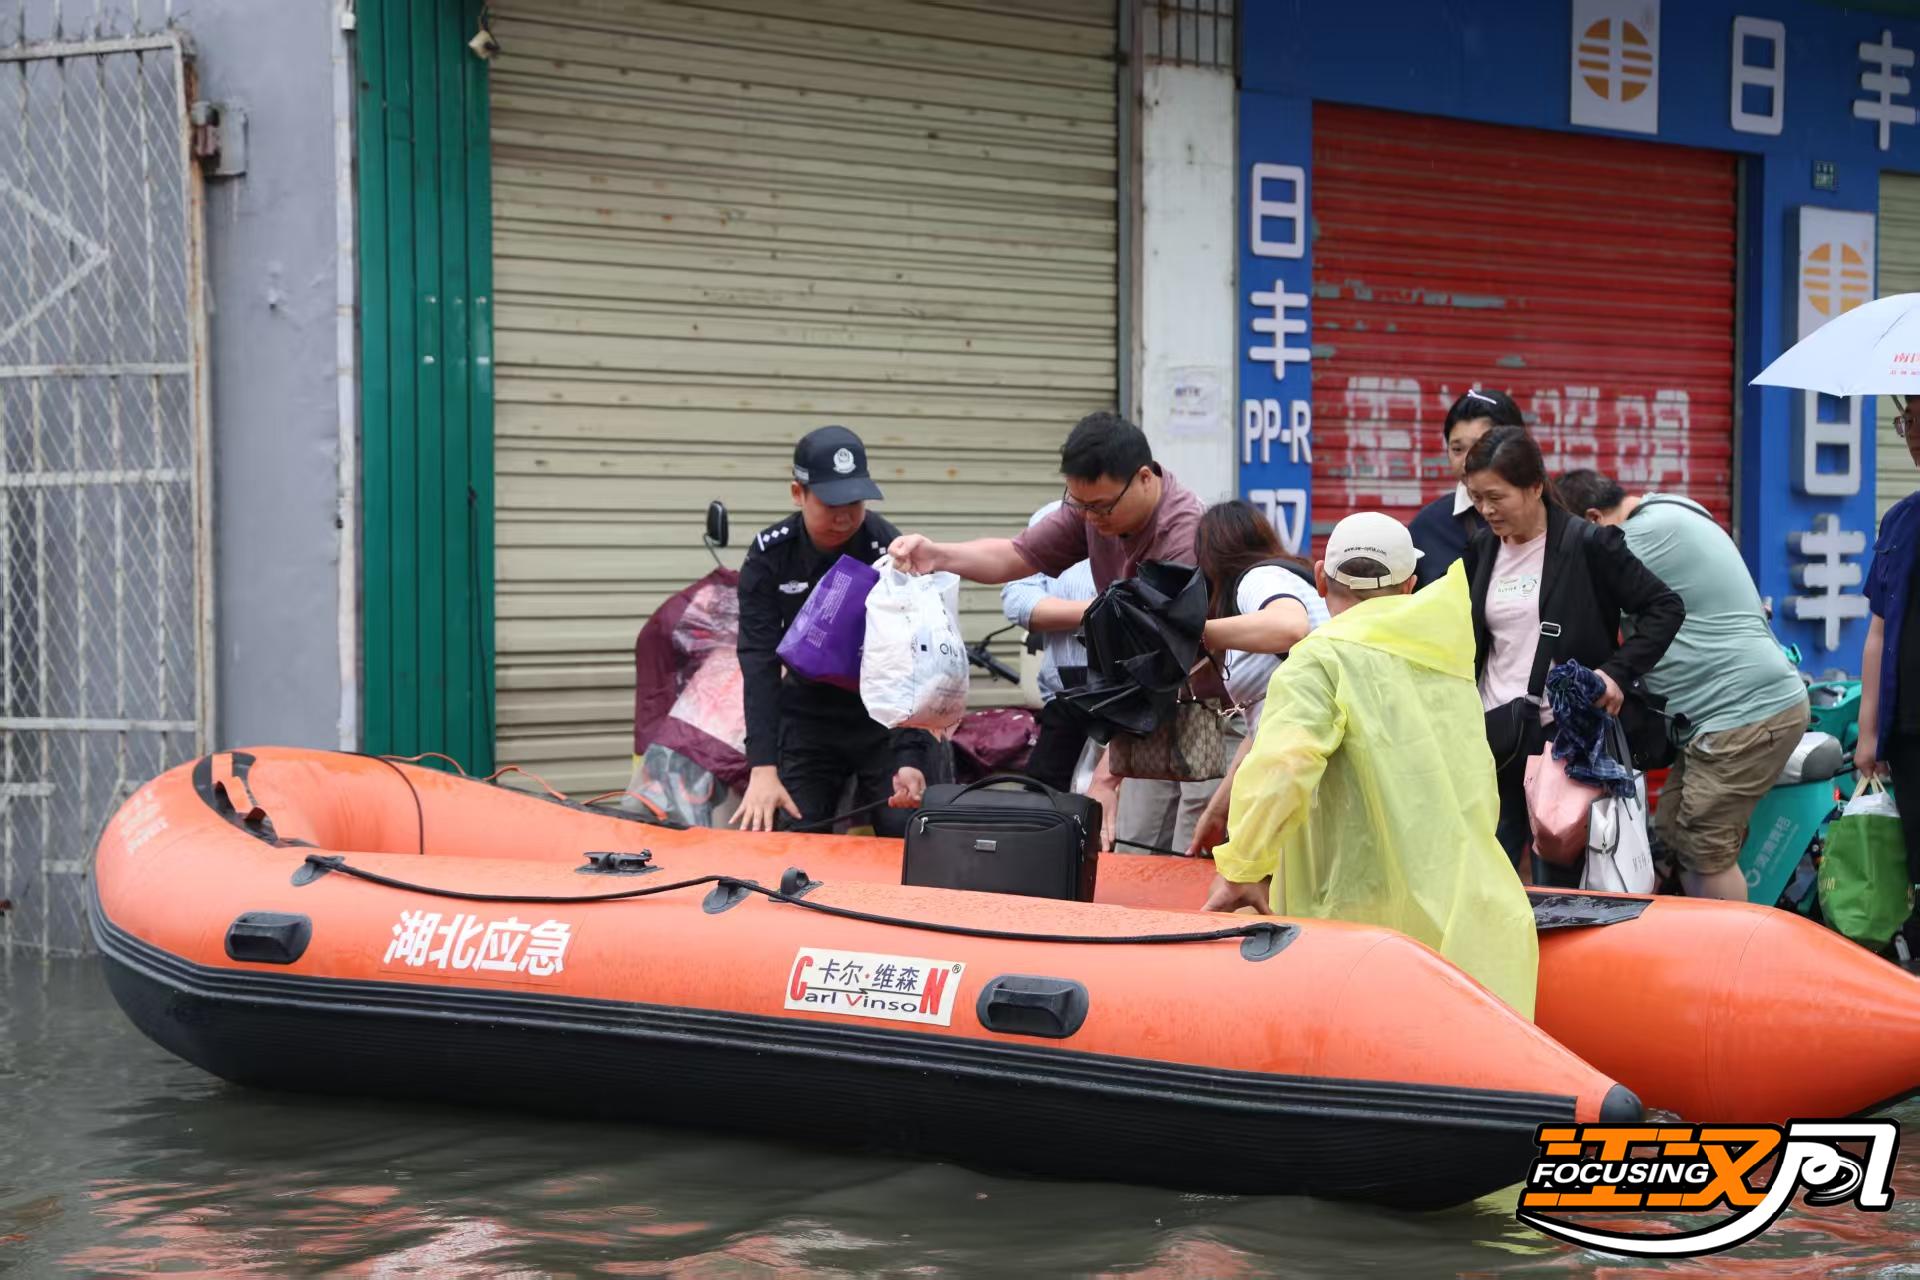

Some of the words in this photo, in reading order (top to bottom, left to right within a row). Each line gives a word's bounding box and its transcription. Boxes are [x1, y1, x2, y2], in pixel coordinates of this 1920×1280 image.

[1731, 15, 1916, 150] 日丰
[1249, 162, 1311, 381] 日丰
[1243, 398, 1313, 464] PP-R
[1796, 391, 1871, 651] 日丰
[383, 910, 571, 976] 湖北应急
[819, 958, 920, 992] 卡尔·维森
